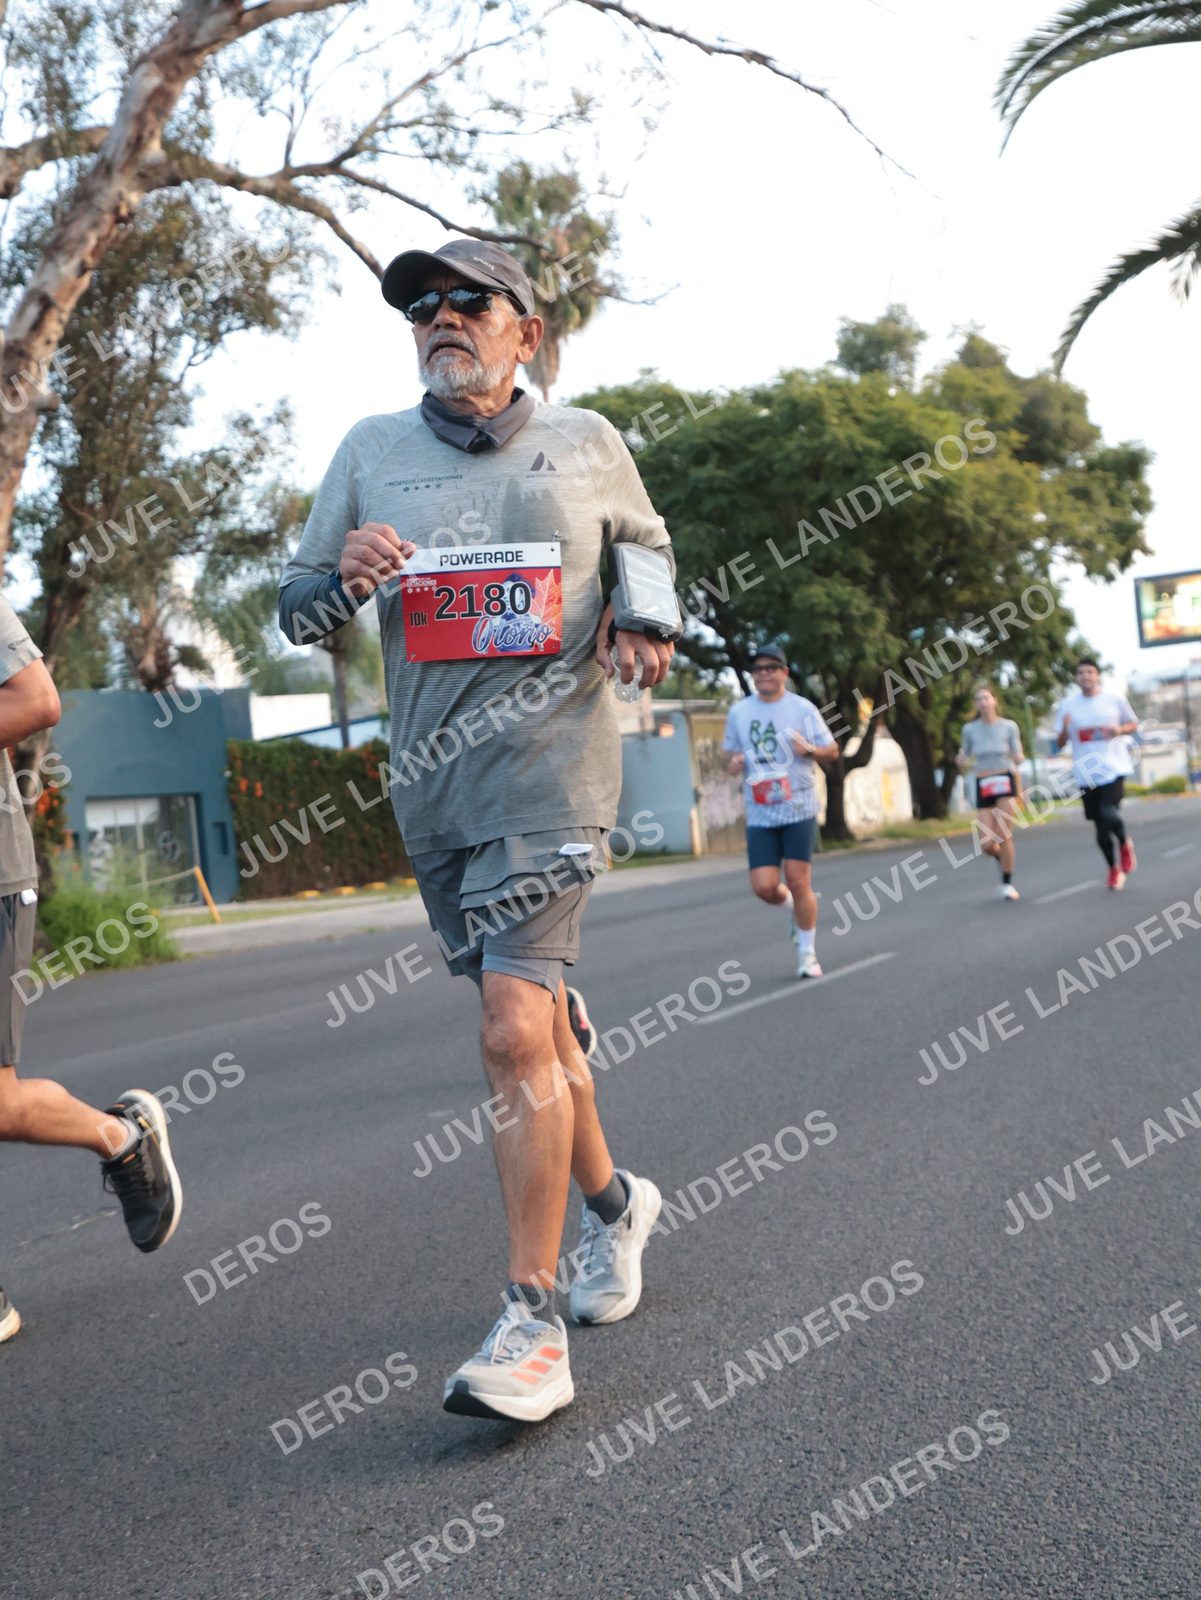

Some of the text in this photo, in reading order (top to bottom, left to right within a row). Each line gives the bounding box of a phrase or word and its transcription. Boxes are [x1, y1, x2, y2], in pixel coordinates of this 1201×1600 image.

[440, 551, 524, 566] POWERADE
[433, 581, 532, 621] 2180
[410, 611, 427, 627] 10k
